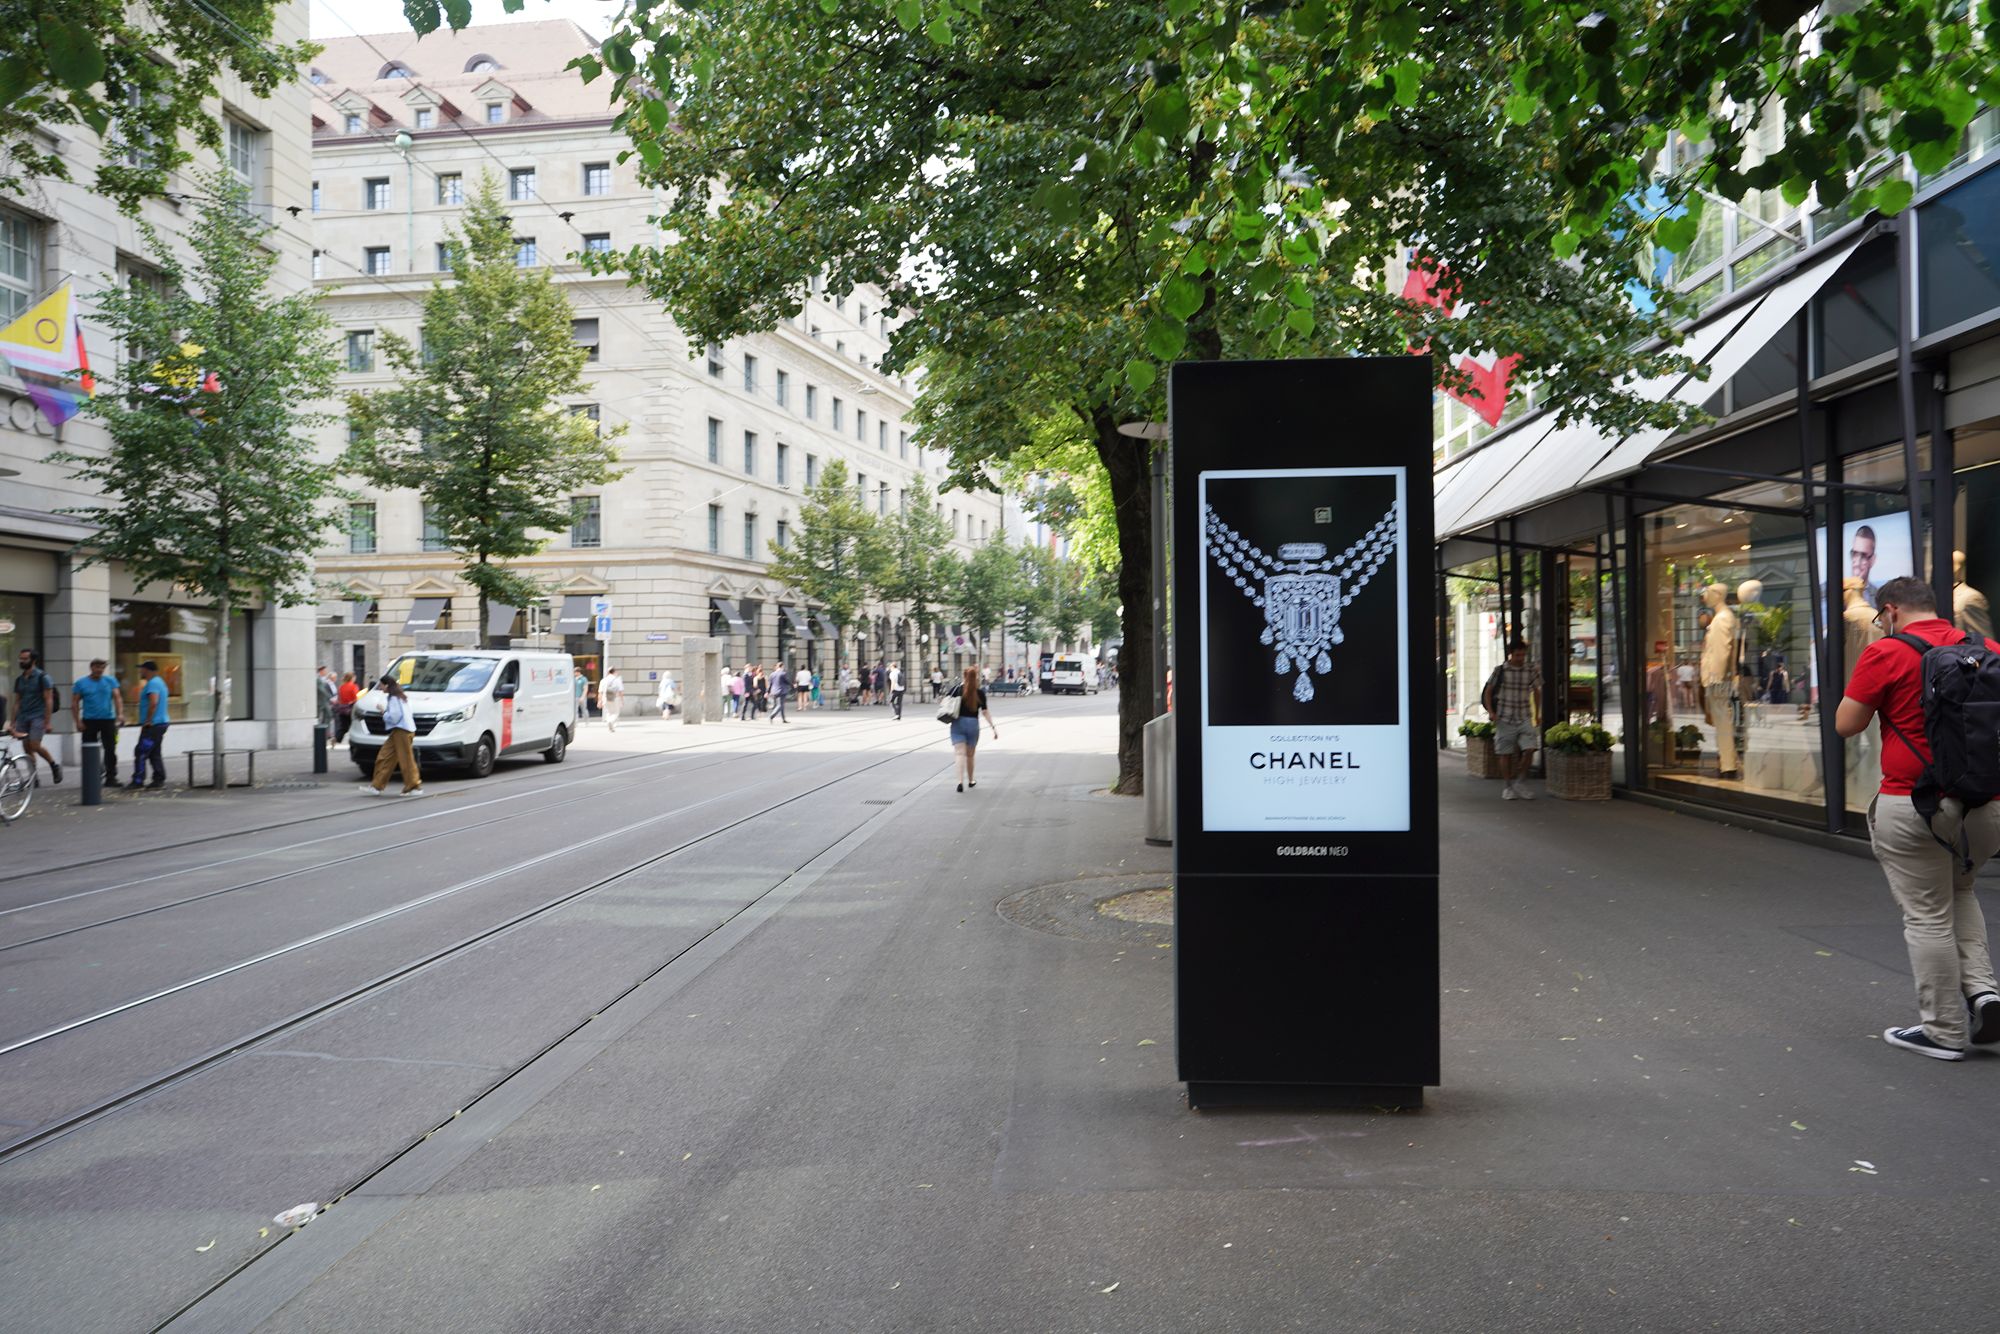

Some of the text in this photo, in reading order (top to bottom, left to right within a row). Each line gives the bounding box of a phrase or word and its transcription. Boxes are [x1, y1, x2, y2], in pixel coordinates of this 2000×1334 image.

[1250, 752, 1360, 769] CHANEL
[1263, 776, 1347, 786] HIGH JEWELRY
[1276, 846, 1349, 857] GOLDBACH NEO
